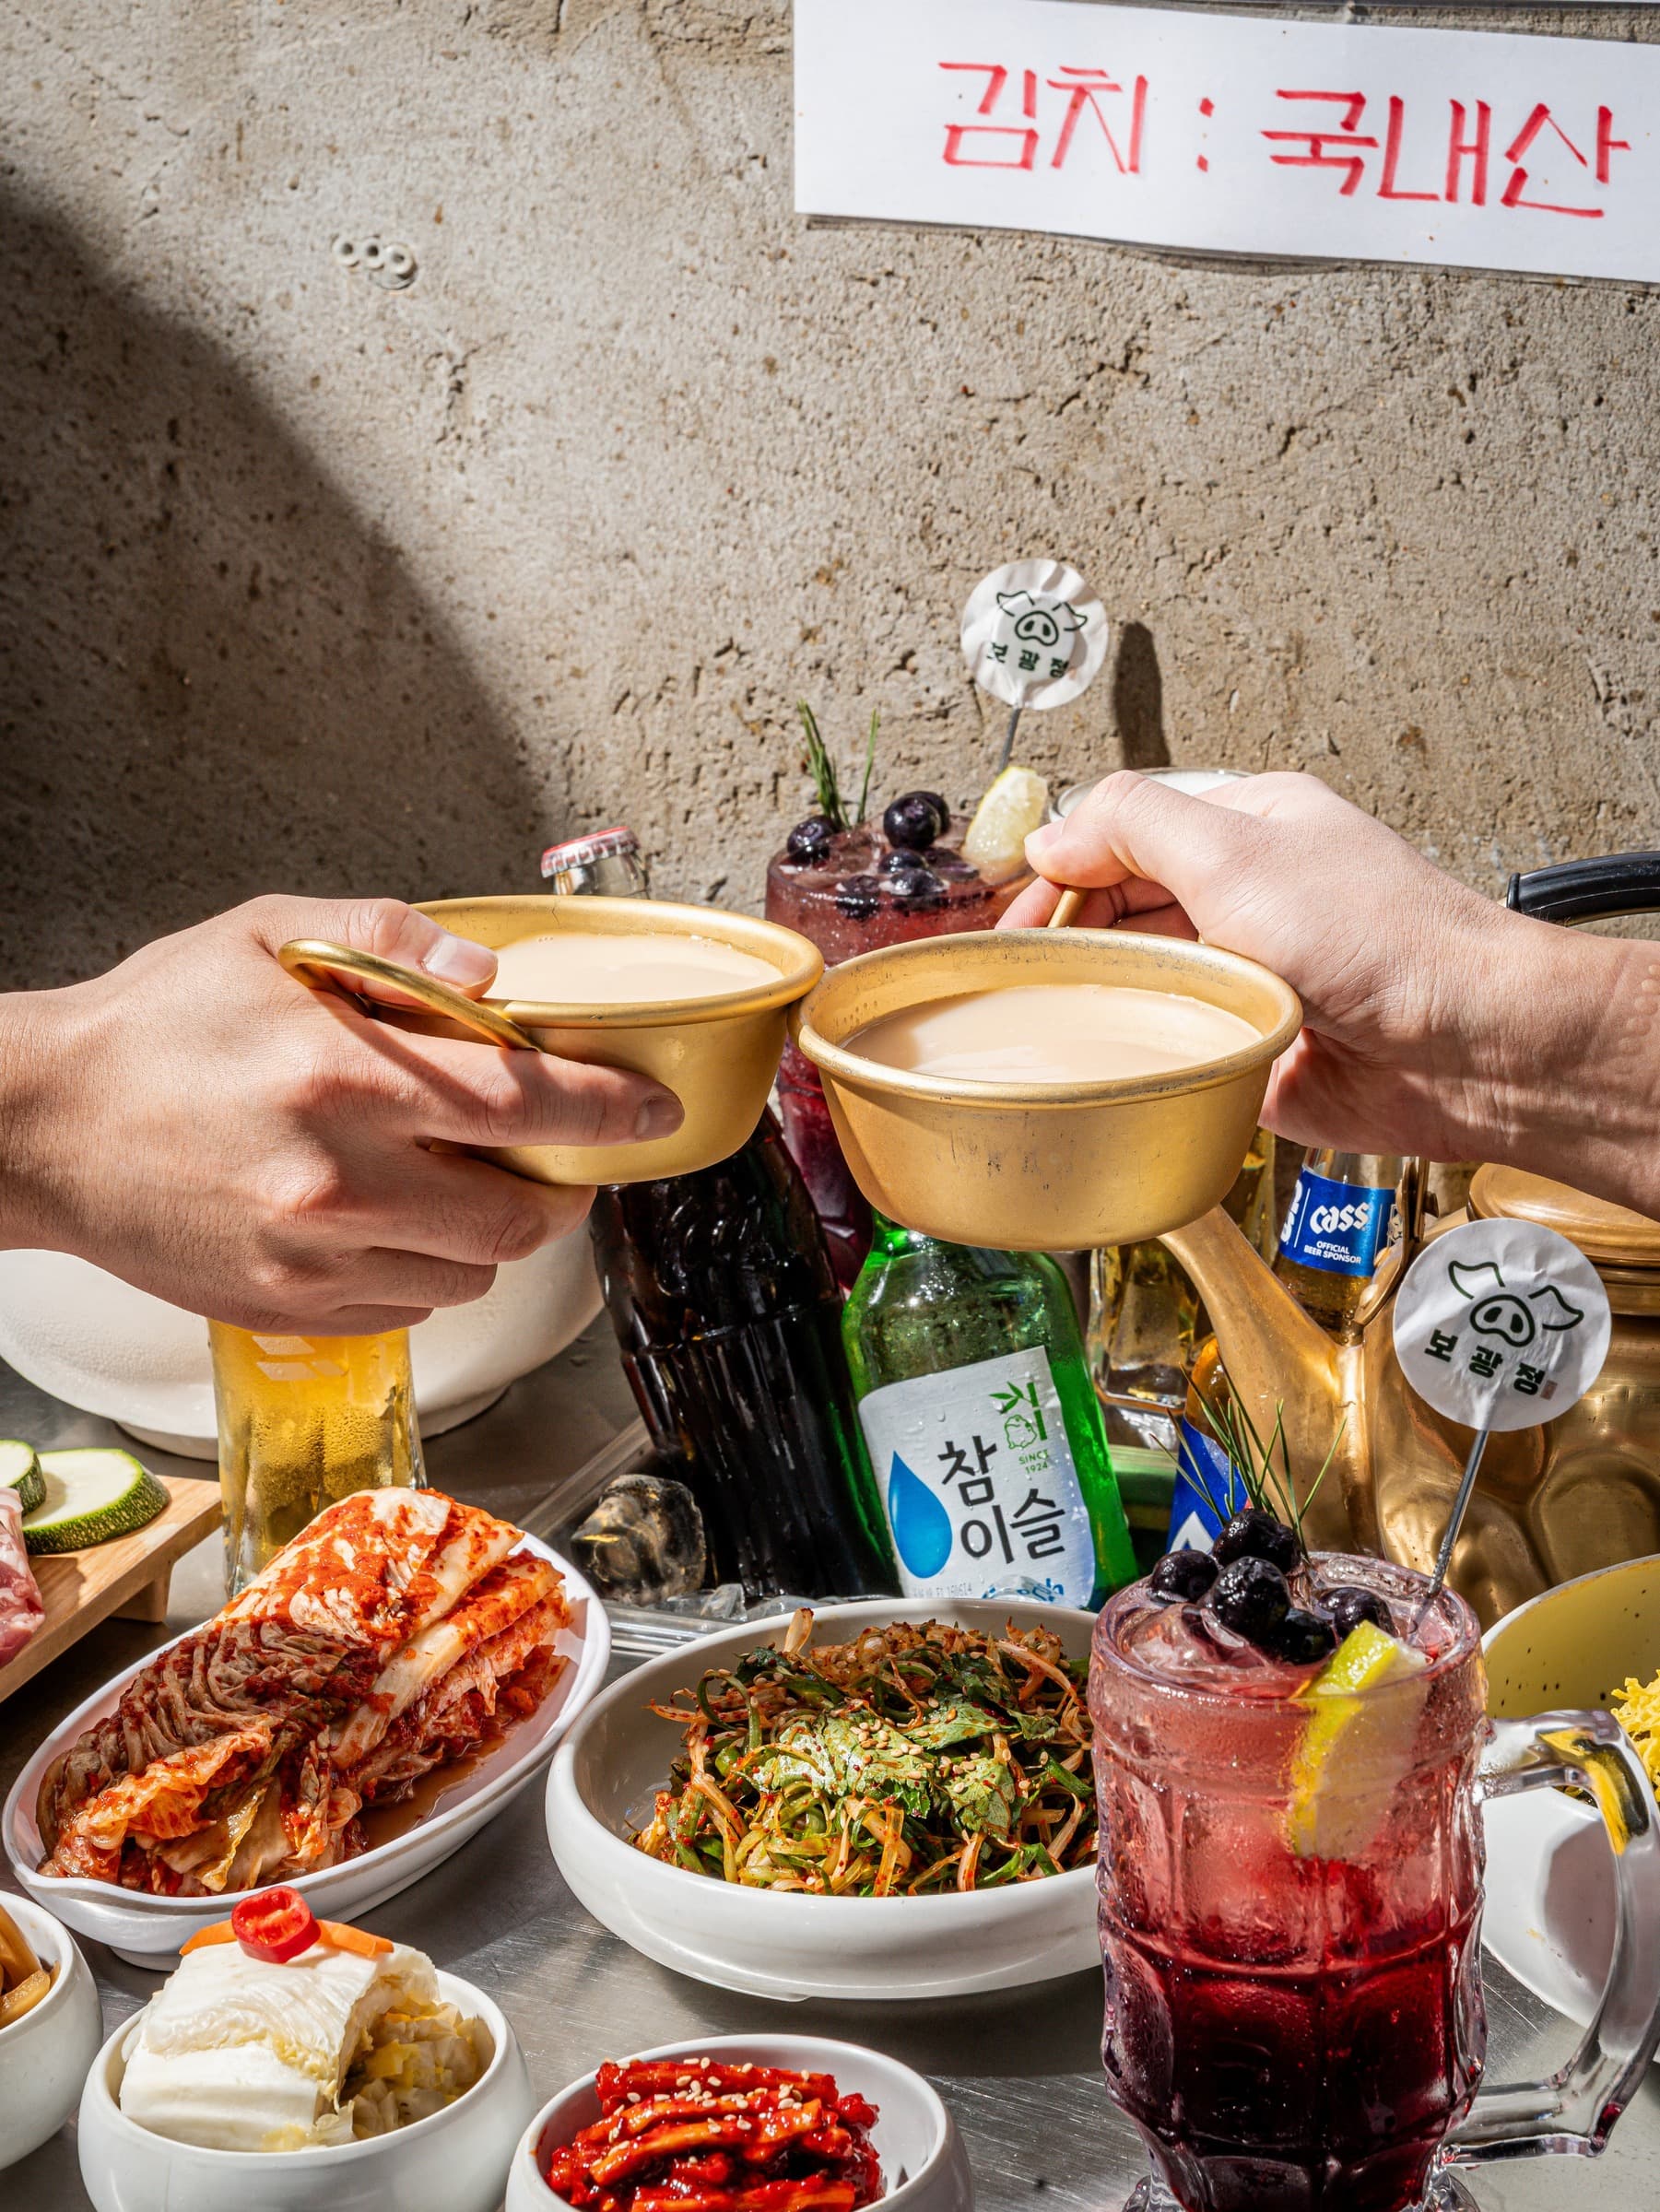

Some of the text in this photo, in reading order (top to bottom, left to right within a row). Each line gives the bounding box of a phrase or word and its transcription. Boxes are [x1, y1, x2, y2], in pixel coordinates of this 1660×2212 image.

[938, 62, 1149, 175] 김치
[1260, 88, 1631, 218] 국내산
[1303, 1244, 1362, 1265] BEER SPONSOR
[1316, 1240, 1350, 1255] OFFICIAL
[1424, 1329, 1546, 1396] 보광정
[1025, 1460, 1048, 1475] 1924
